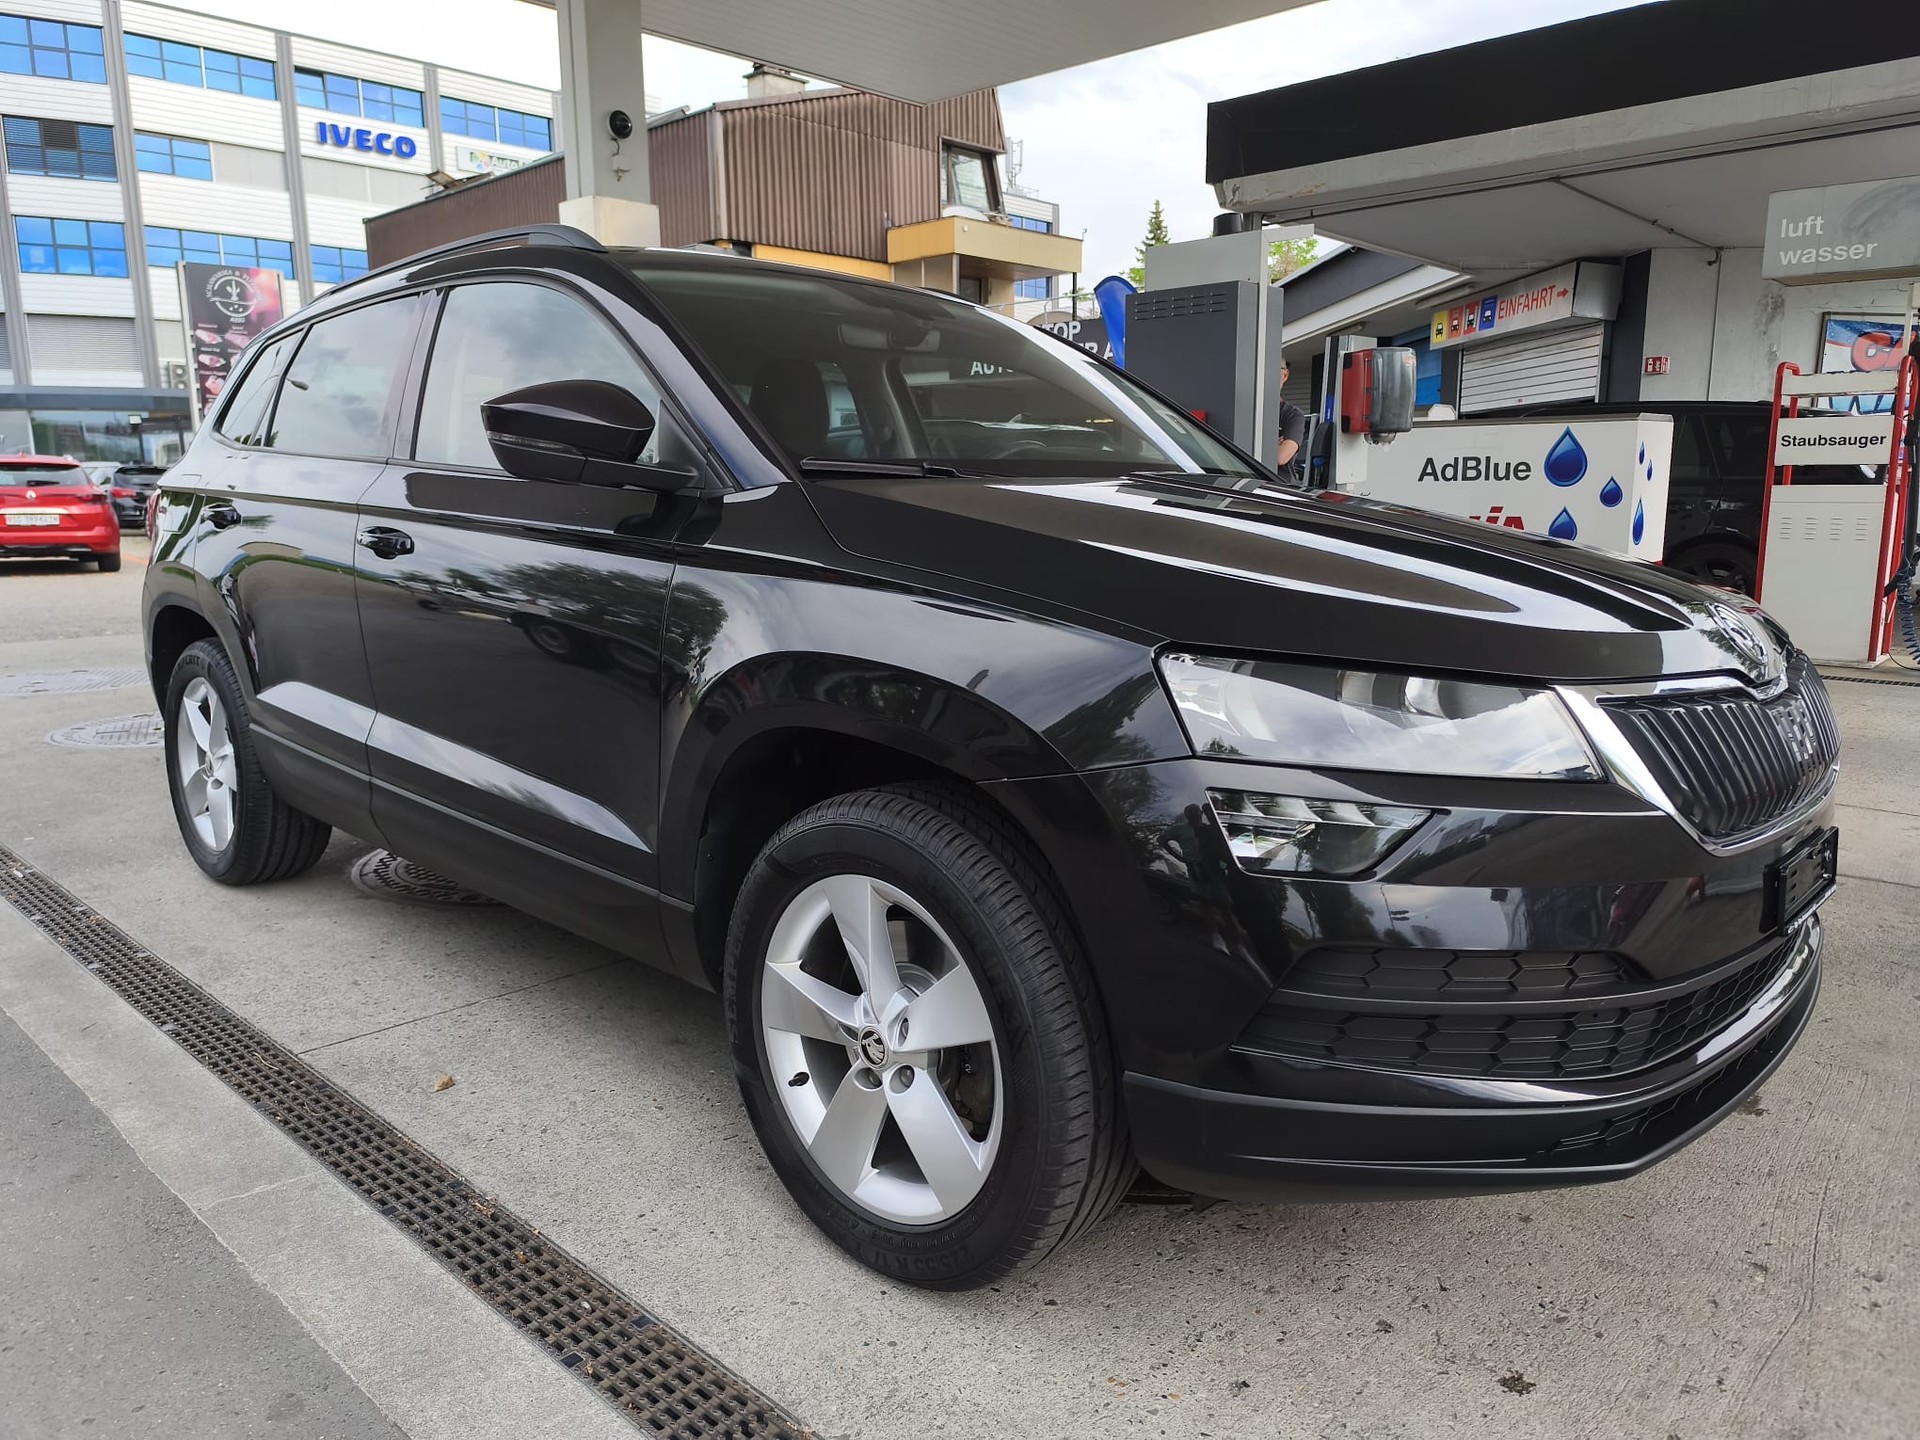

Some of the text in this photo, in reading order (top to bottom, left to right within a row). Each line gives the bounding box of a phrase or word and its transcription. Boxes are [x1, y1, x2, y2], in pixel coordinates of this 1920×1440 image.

[317, 121, 417, 158] IVECO
[1780, 215, 1824, 238] luft
[1779, 242, 1878, 265] wasser
[1498, 285, 1556, 320] EINFAHRT
[1781, 434, 1887, 449] Staubsauger
[1417, 456, 1532, 482] AdBlue
